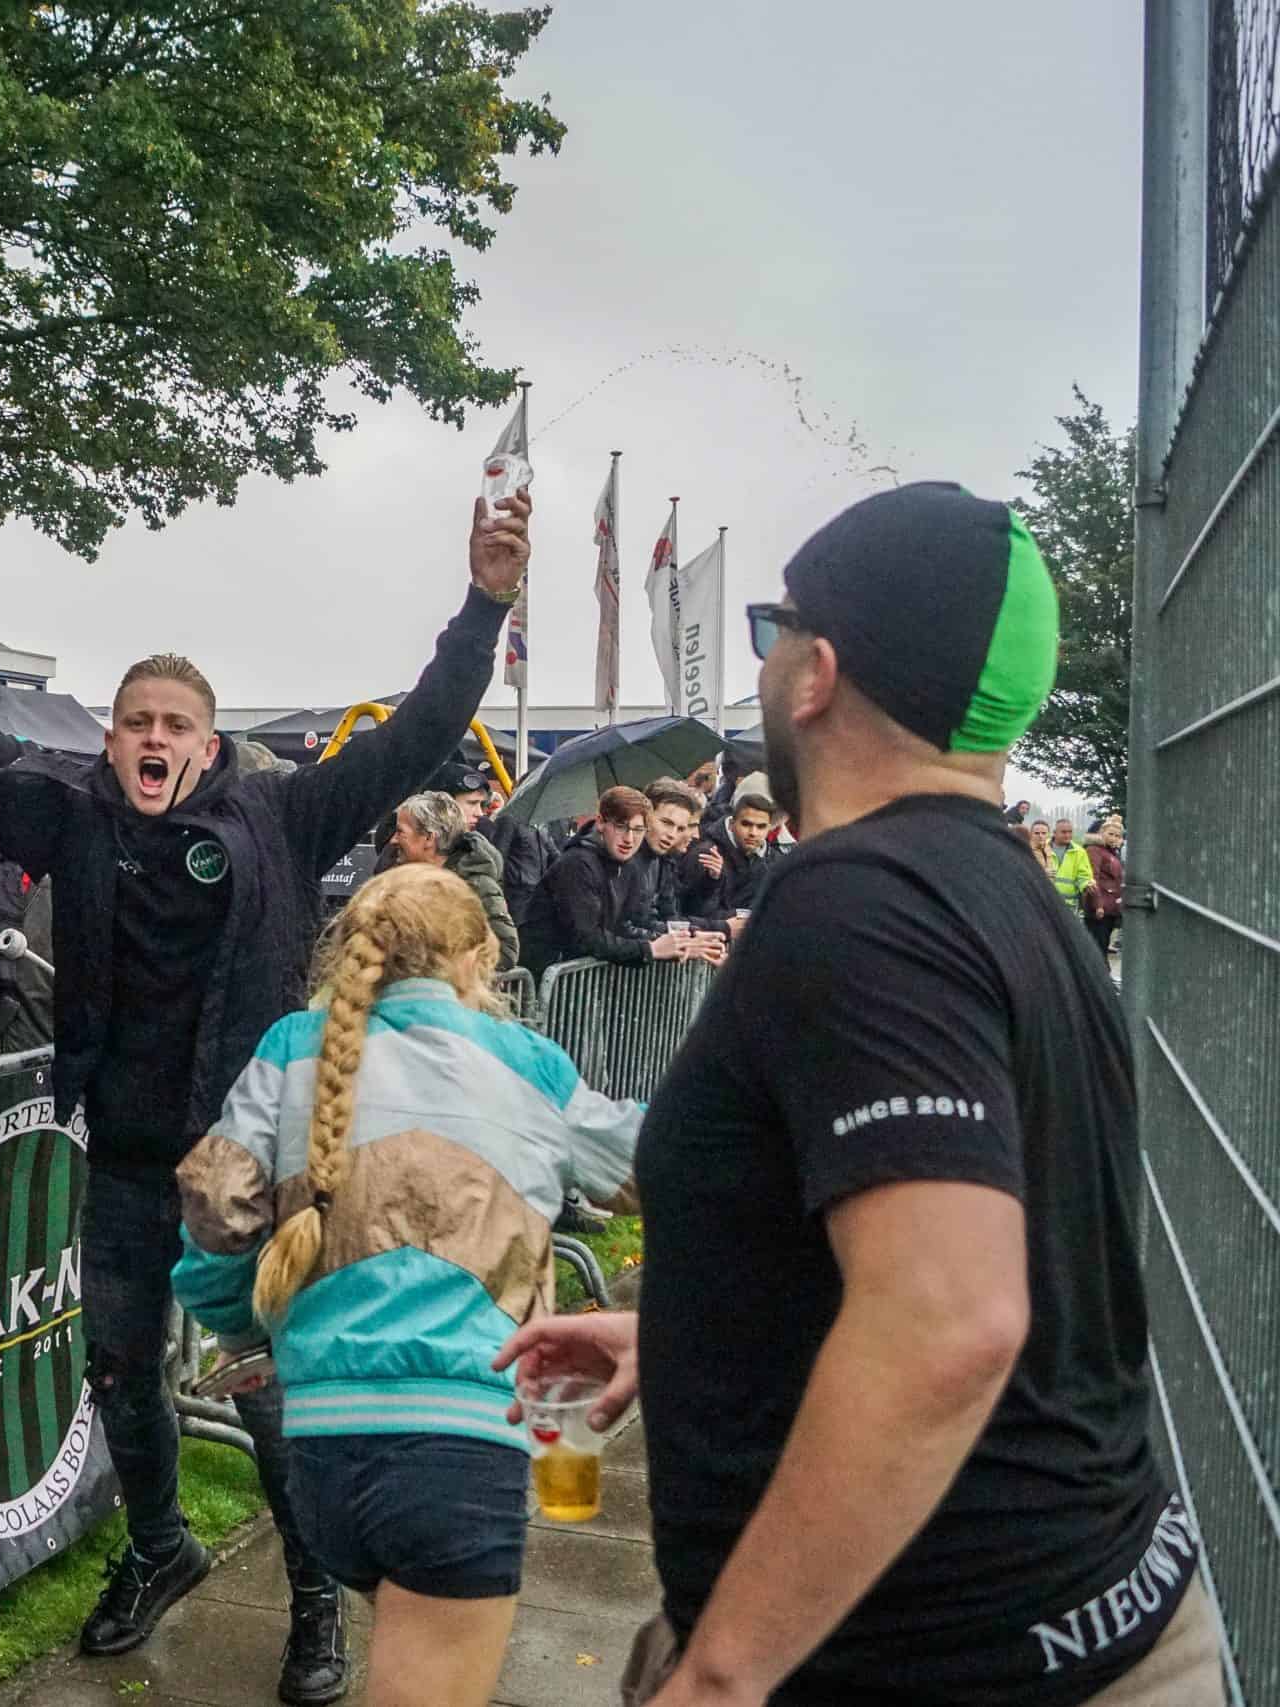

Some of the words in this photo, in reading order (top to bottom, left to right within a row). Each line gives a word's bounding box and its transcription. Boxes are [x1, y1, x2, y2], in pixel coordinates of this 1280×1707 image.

[832, 1096, 911, 1136] SINCE
[916, 1095, 985, 1121] 2011
[33, 1325, 73, 1360] 2011
[61, 1386, 94, 1473] BOYS
